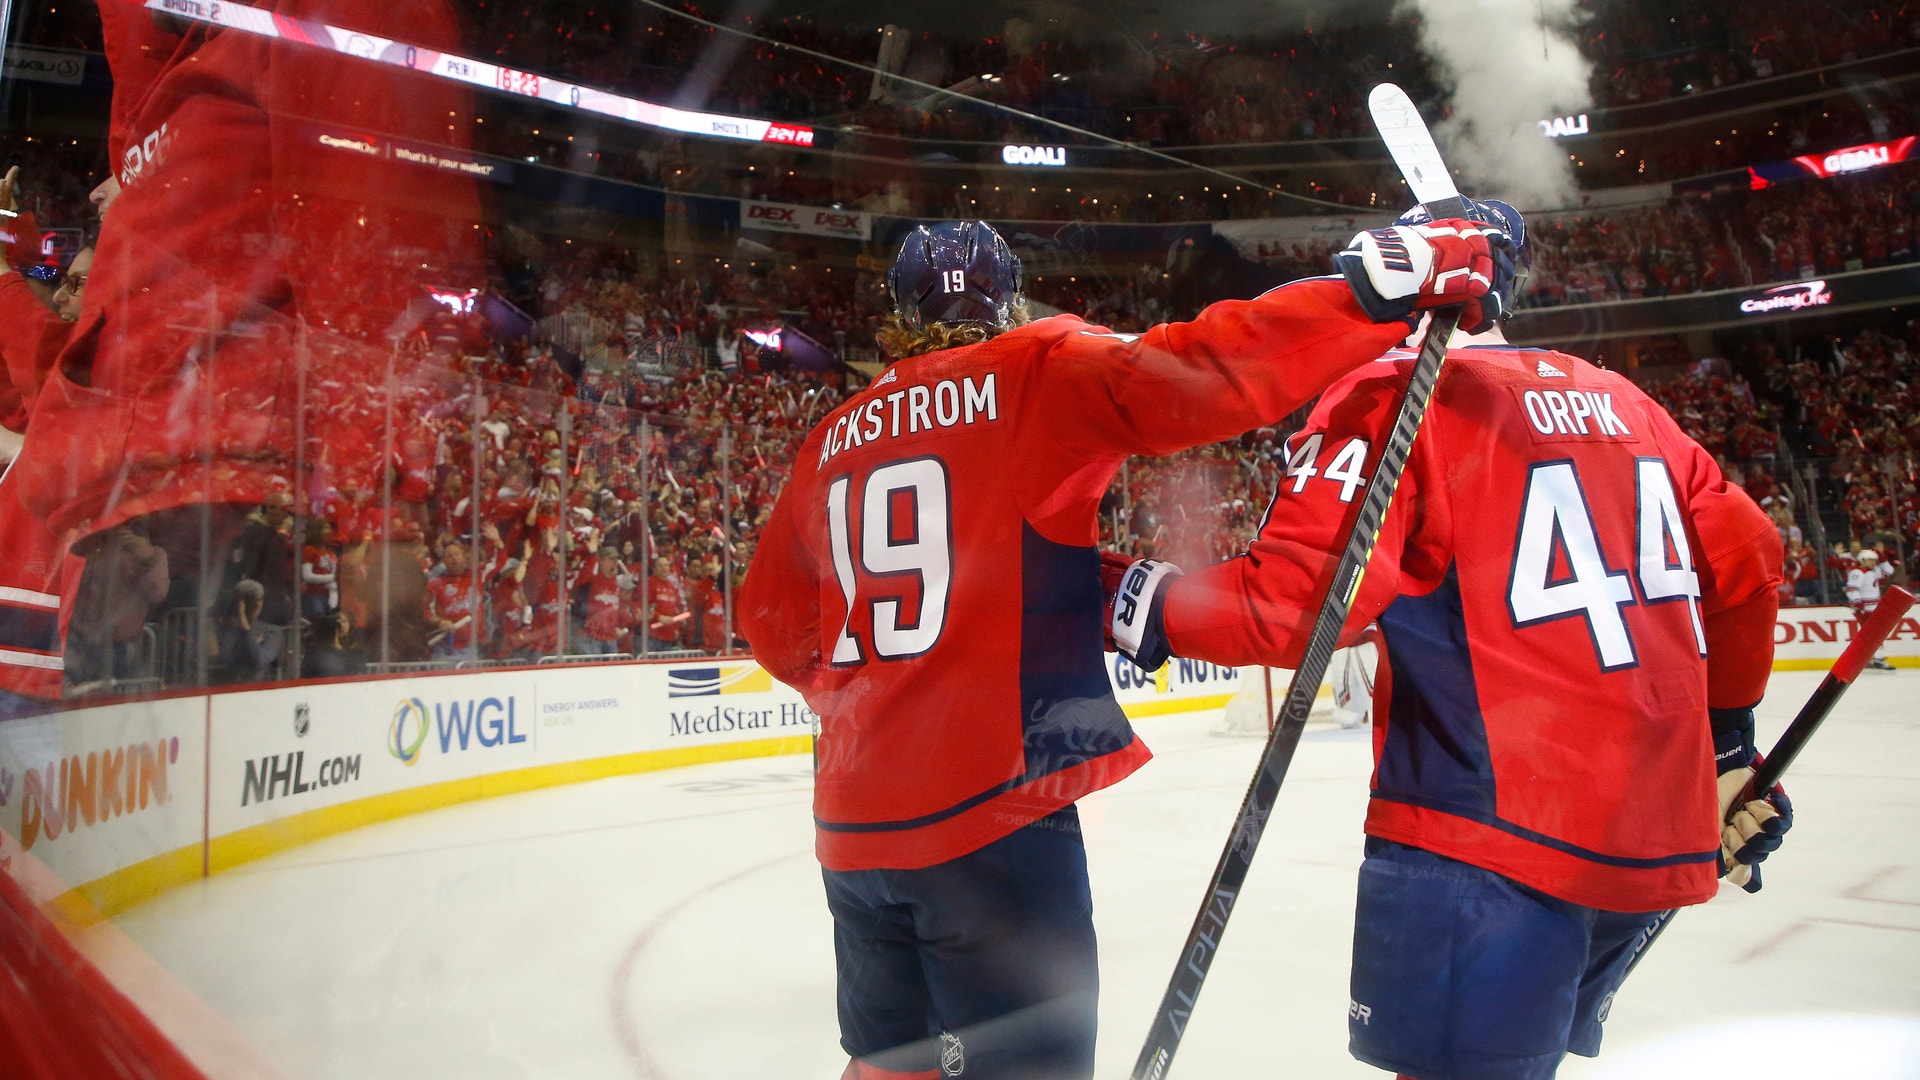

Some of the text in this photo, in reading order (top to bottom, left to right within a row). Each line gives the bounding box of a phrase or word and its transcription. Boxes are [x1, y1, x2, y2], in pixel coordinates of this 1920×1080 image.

[210, 3, 221, 21] 2
[405, 46, 417, 68] 0
[447, 60, 470, 76] PER
[496, 66, 540, 97] 16:23
[570, 86, 580, 107] 0
[795, 130, 814, 144] PM
[395, 147, 427, 164] What's
[438, 155, 459, 168] your
[749, 205, 795, 222] DEX
[814, 211, 861, 228] DEX
[942, 269, 965, 293] 19
[818, 372, 998, 471] ACKSTROM
[1523, 389, 1632, 437] ORPIK
[1285, 433, 1369, 503] 44
[826, 453, 953, 667] 19
[1507, 457, 1709, 674] 44
[543, 702, 575, 714] ENERGY
[669, 704, 773, 737] MedStar
[435, 696, 527, 754] WGL
[1714, 745, 1742, 761] AUER
[20, 736, 180, 853] DUNKIN'
[1165, 888, 1236, 1041] ALPHA
